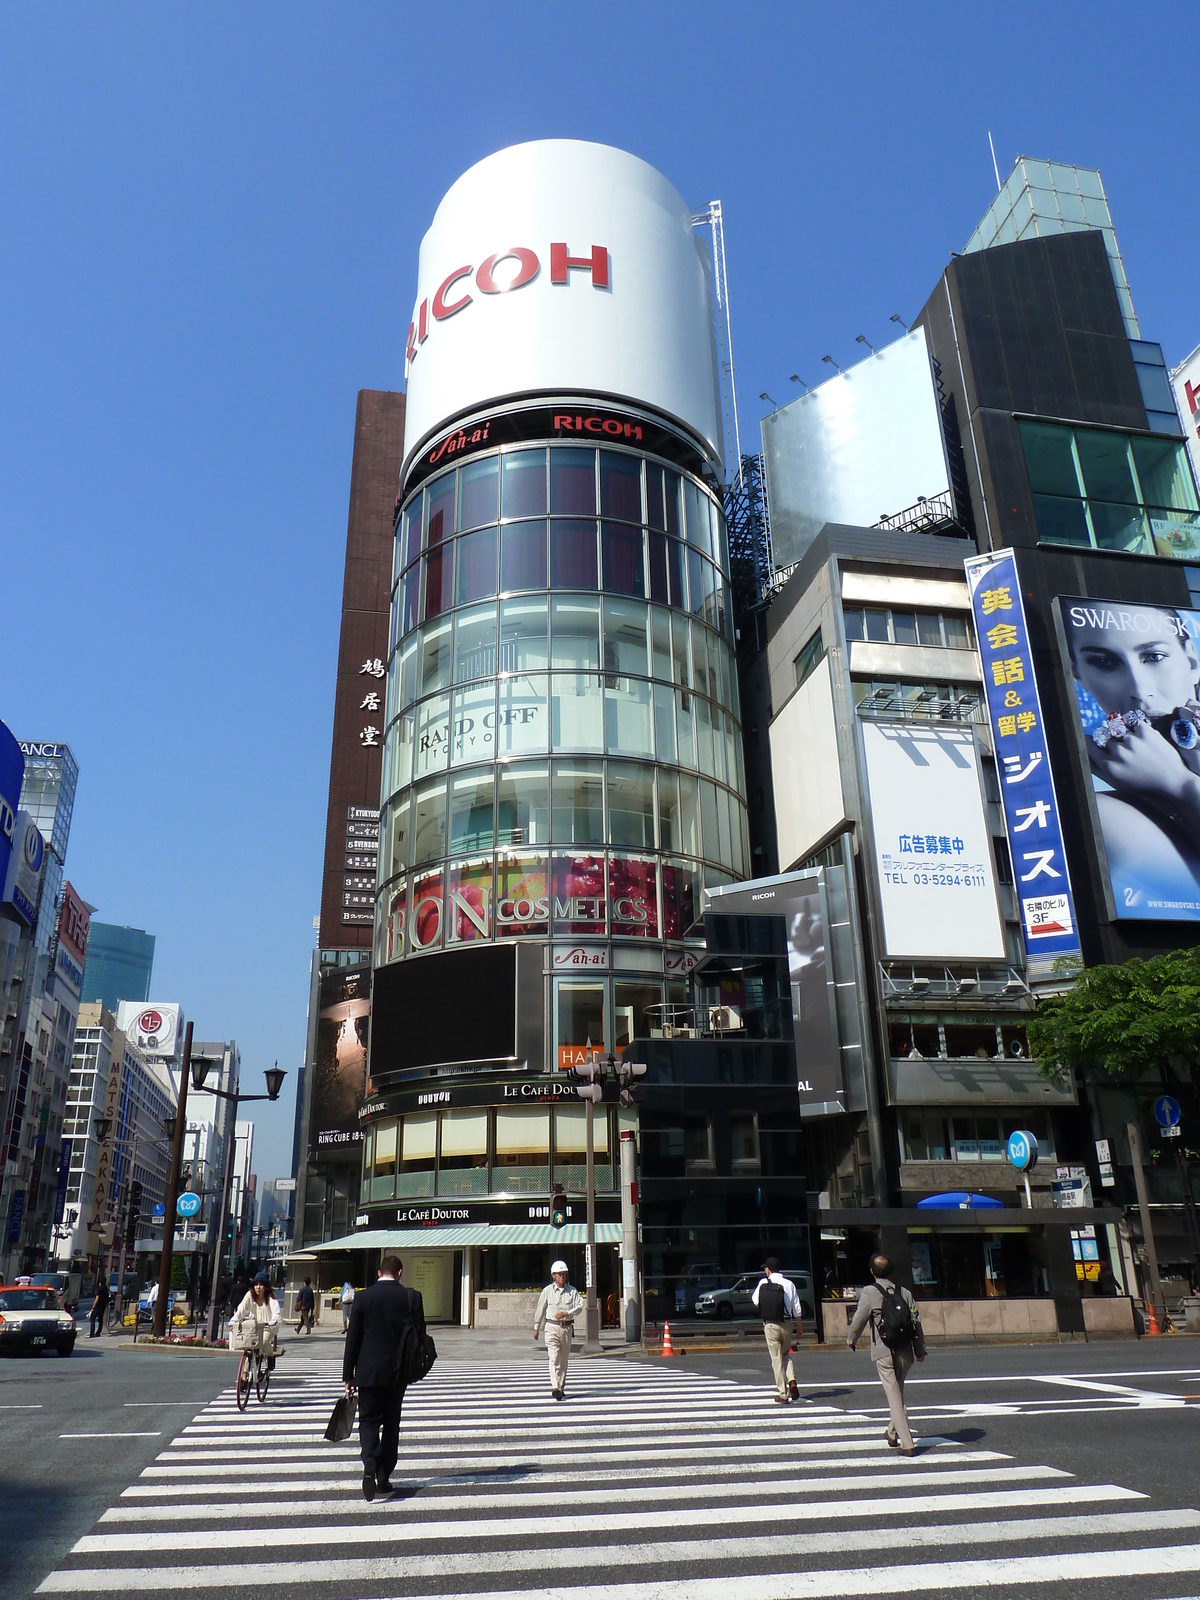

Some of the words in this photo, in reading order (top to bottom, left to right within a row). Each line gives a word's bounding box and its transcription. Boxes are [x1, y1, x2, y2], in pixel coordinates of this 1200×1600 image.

[406, 242, 608, 364] RICOH
[553, 415, 643, 440] RICOH
[429, 422, 490, 463] San-ai
[359, 658, 385, 747] 鳩居堂
[483, 707, 538, 729] OFF
[19, 743, 61, 758] ANCL
[433, 733, 492, 758] TOKYO
[1003, 751, 1061, 883] ジオス
[354, 840, 379, 849] SVENSON
[899, 834, 965, 855] 広告募集中
[884, 873, 908, 884] TEL
[913, 873, 986, 887] 03-5294-6111
[752, 892, 776, 901] RICOH
[1027, 899, 1066, 913] 右隣のビル
[342, 912, 350, 920] B
[389, 884, 491, 960] BON
[1032, 912, 1049, 924] 3F
[555, 948, 606, 965] San-ai
[346, 973, 361, 982] RICOH
[138, 1035, 158, 1049] LG
[418, 1091, 451, 1105] DOUTOR
[318, 1134, 333, 1144] RING
[334, 1132, 350, 1142] CUBE
[10, 1197, 23, 1236] FANCL
[431, 1207, 469, 1220] DOUTOR
[528, 1206, 572, 1218] DOUR
